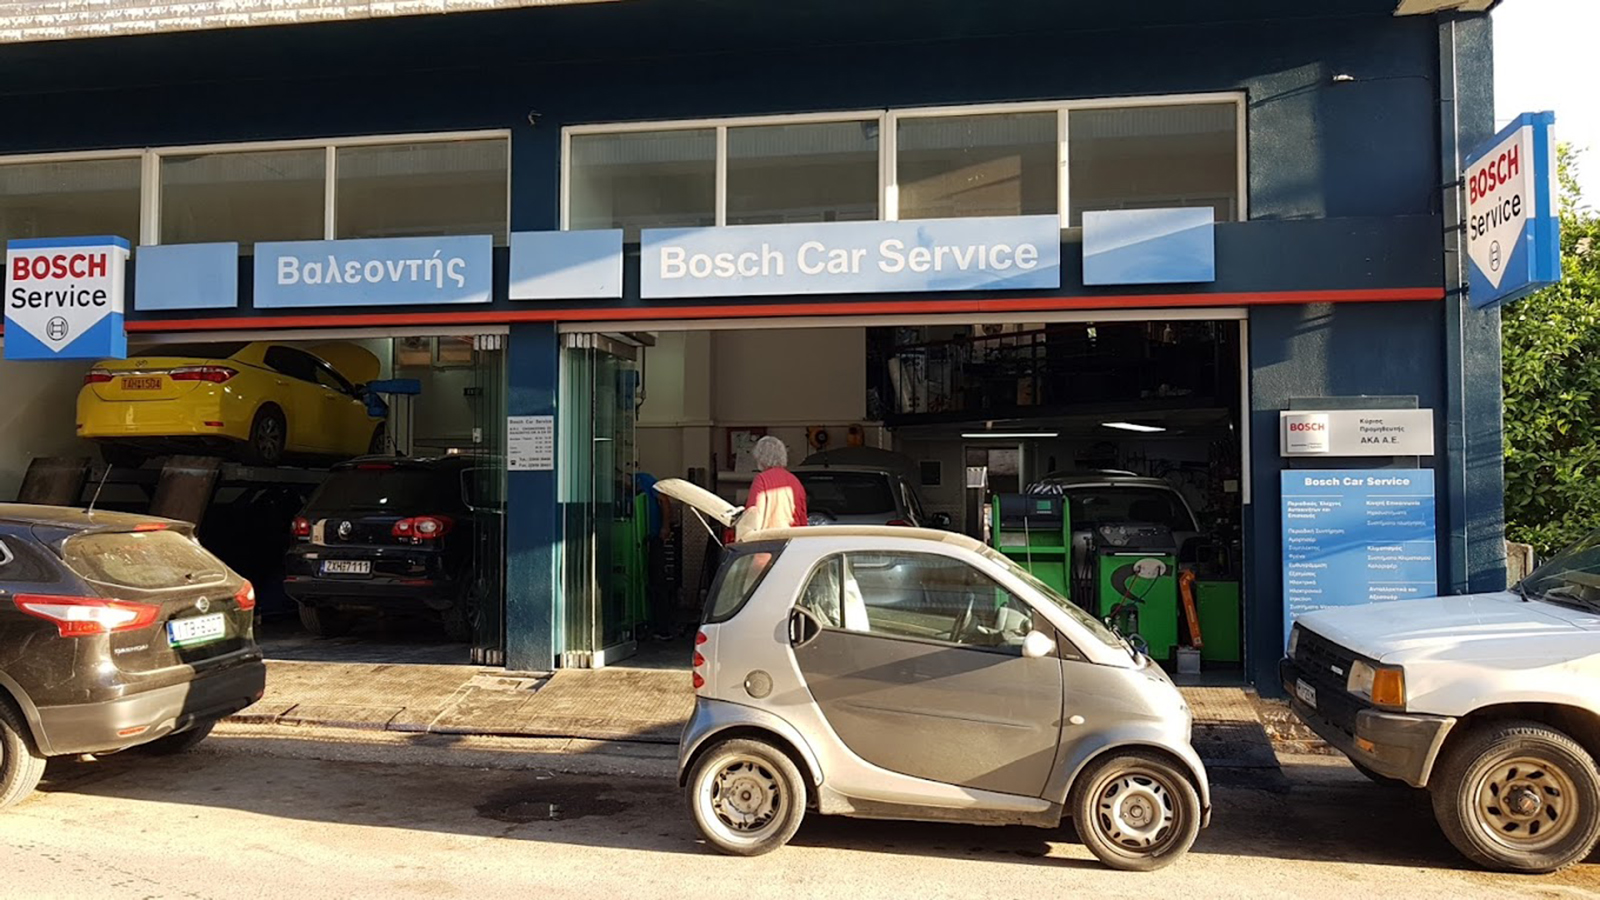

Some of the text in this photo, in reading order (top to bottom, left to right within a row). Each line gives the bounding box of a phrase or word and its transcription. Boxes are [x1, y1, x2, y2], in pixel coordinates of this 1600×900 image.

[1469, 144, 1518, 206] BOSCH
[1470, 193, 1521, 241] Service
[13, 253, 107, 281] BOSCH
[277, 249, 466, 289] Βαλεοντής
[659, 239, 1039, 280] Bosch Car Service
[11, 284, 107, 309] Service
[1290, 422, 1325, 431] BOSCH
[1304, 476, 1411, 486] Bosch Car Service
